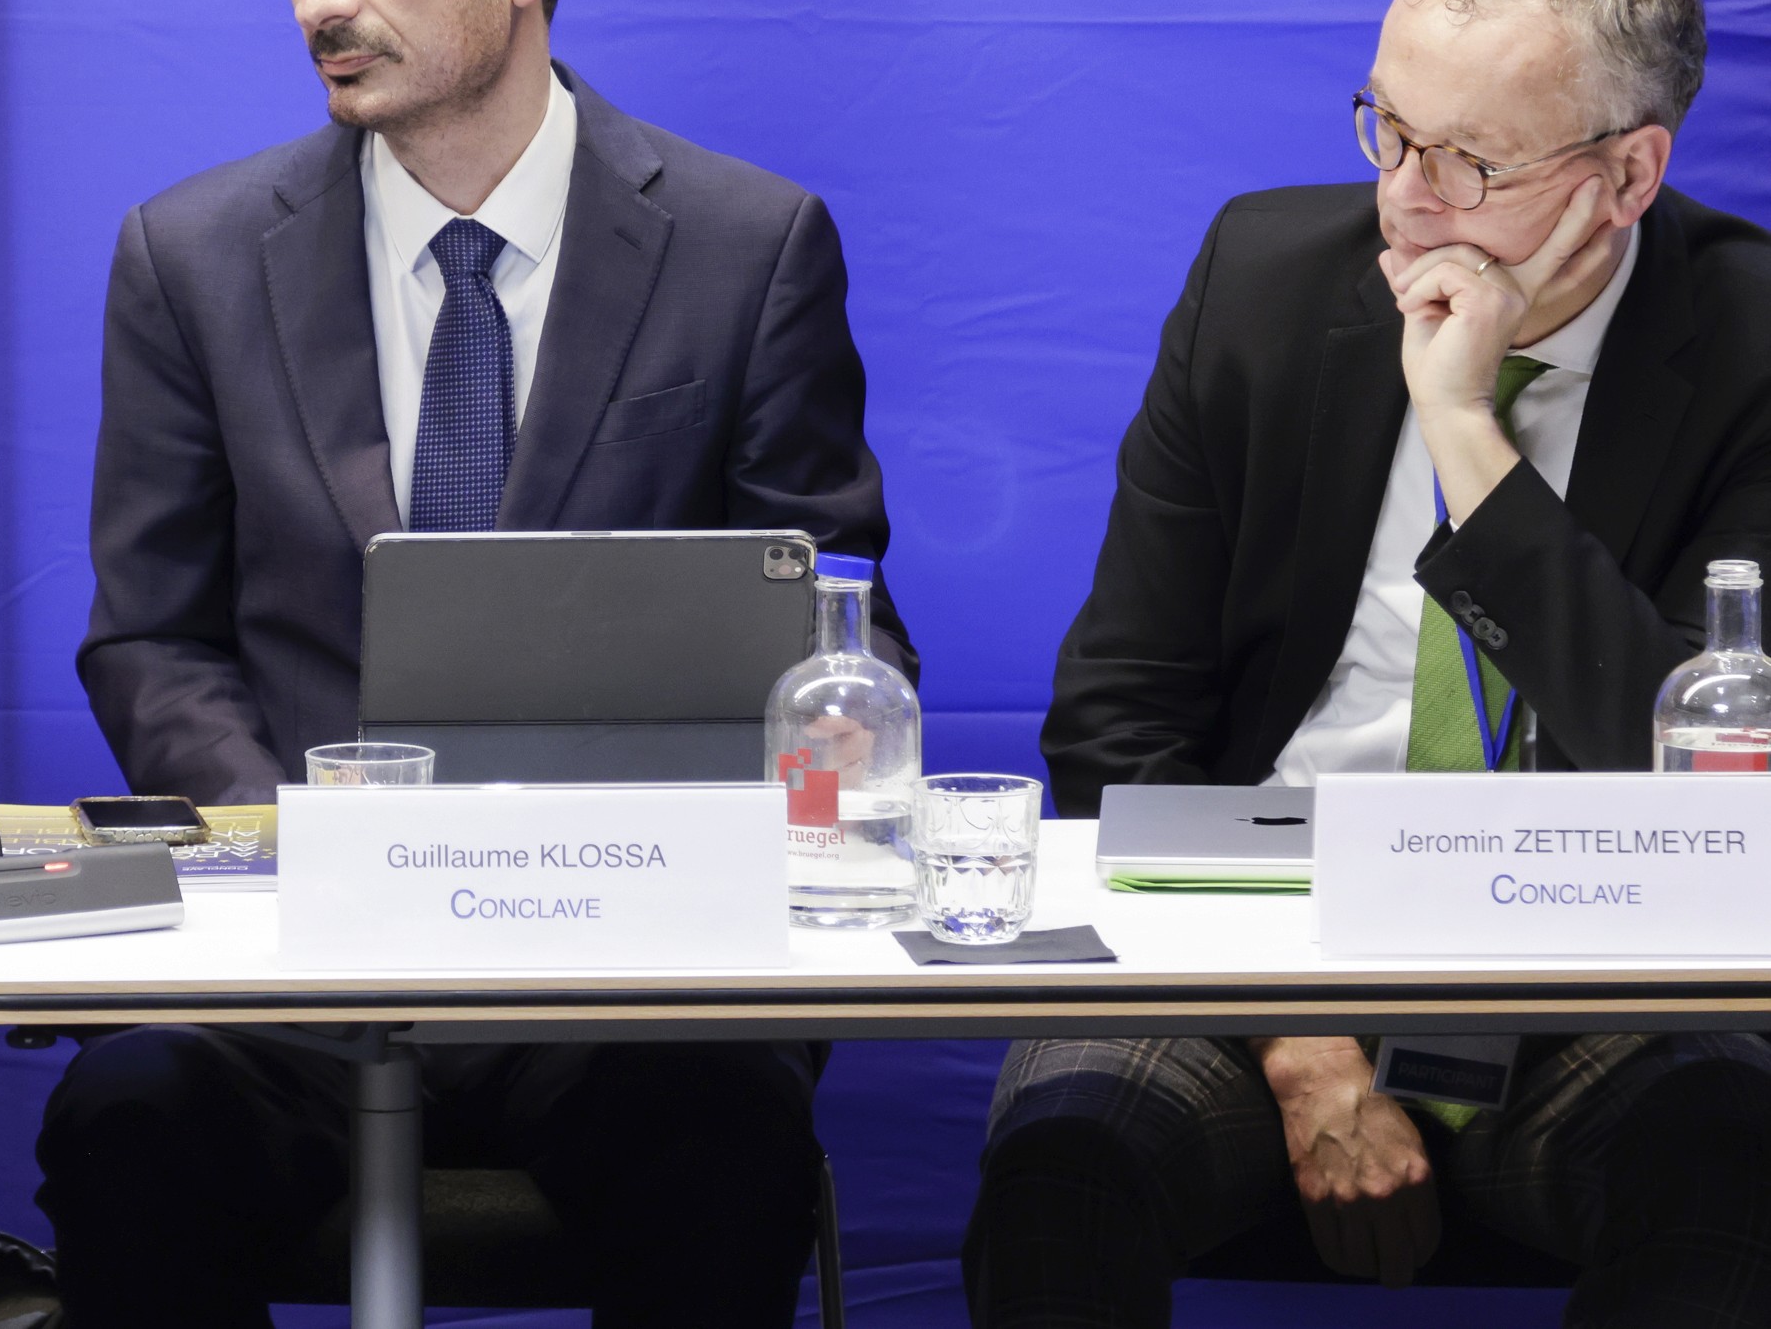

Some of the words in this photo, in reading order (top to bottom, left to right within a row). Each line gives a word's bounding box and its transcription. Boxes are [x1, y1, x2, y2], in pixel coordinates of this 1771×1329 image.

[786, 828, 847, 849] ruegel
[1390, 828, 1504, 854] Jeromin
[1513, 828, 1746, 855] ZETTELMEYER
[386, 843, 530, 869] Guillaume
[539, 843, 668, 869] KLOSSA
[786, 850, 841, 861] ww.bruegel.org
[1490, 873, 1643, 905] CONCLAVE
[450, 888, 603, 920] CONCLAVE
